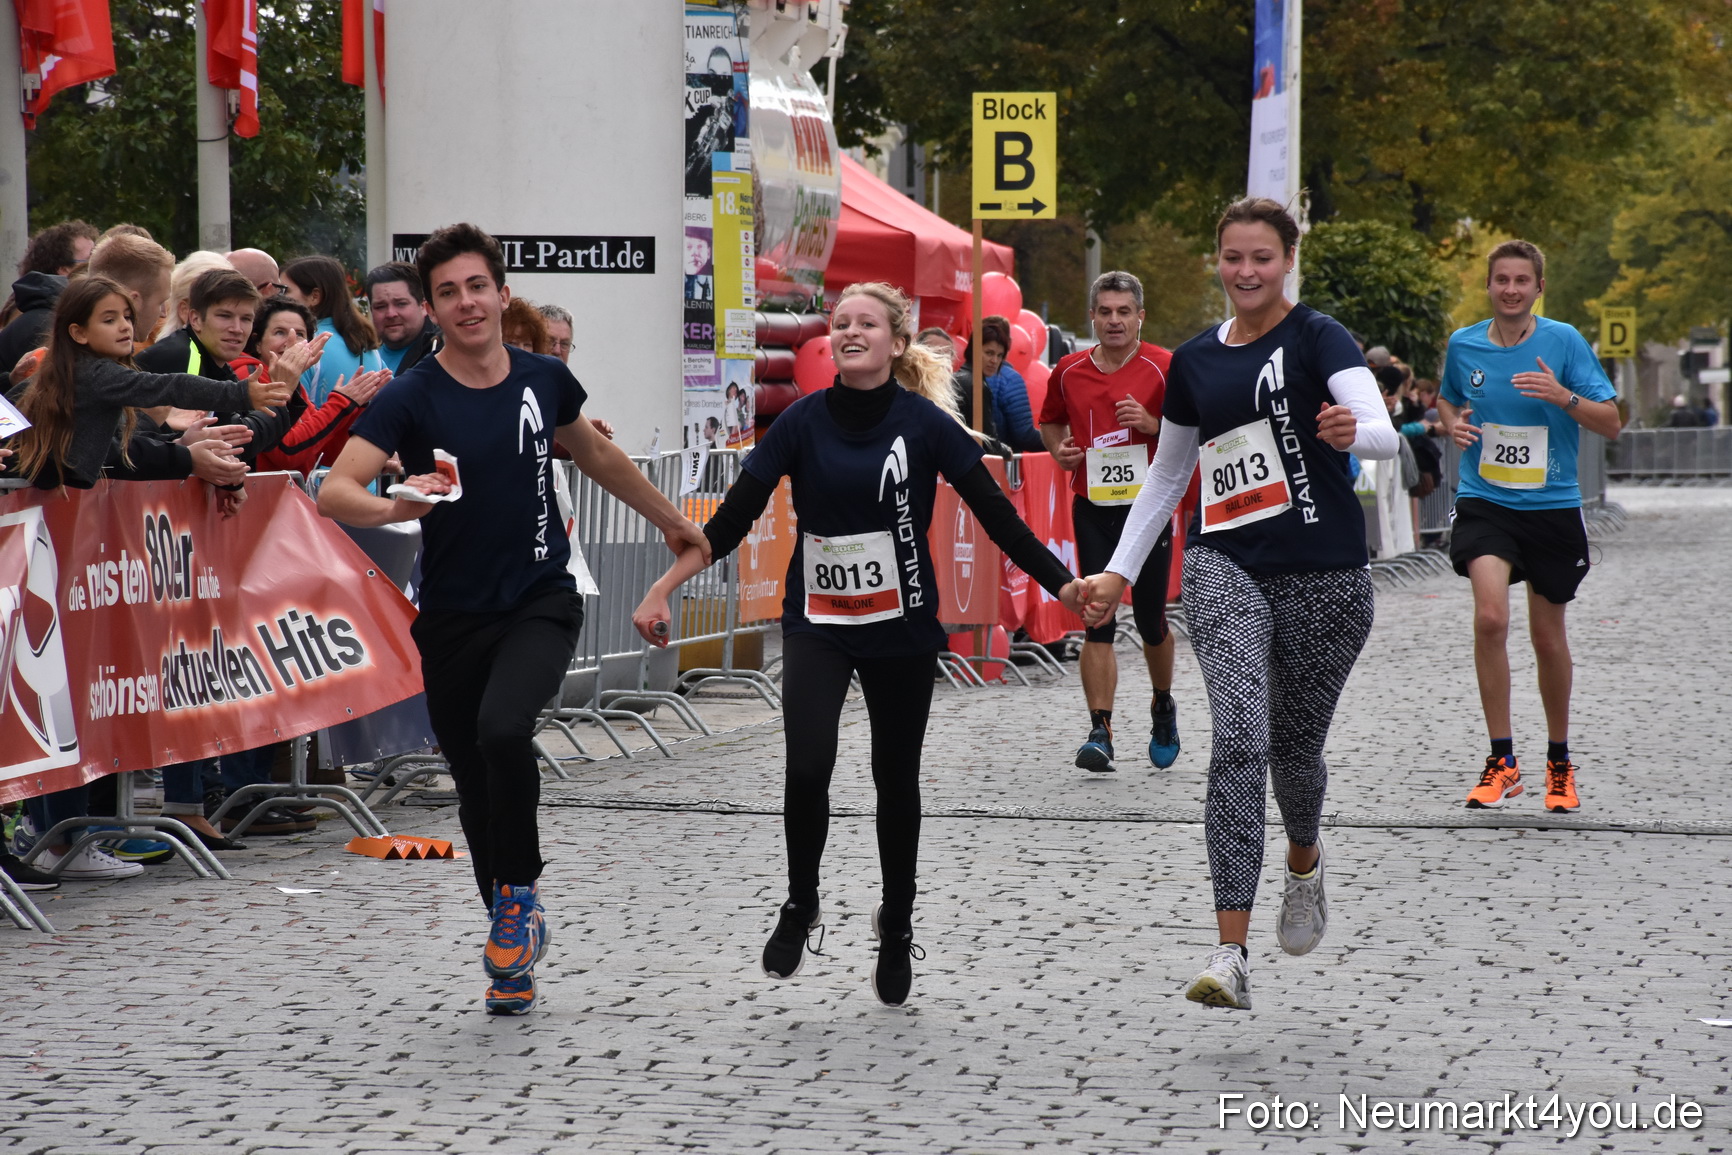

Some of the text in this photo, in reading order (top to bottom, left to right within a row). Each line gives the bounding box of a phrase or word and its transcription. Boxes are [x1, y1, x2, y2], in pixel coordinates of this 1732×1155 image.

[694, 90, 711, 104] CUP
[983, 98, 1046, 120] Block
[995, 131, 1035, 191] B
[716, 191, 739, 215] 18.
[1605, 310, 1631, 319] Block
[1610, 322, 1627, 346] D
[1102, 434, 1119, 444] DEHN
[1271, 397, 1319, 524] RAIL.ONE
[1494, 444, 1530, 465] 283
[1101, 464, 1135, 483] 235
[1212, 452, 1270, 497] 8013
[534, 438, 549, 562] RAIL.ONE
[1110, 488, 1128, 496] Josef
[1225, 492, 1263, 514] RAIL.ONE
[832, 543, 865, 554] BOCK
[896, 488, 923, 608] RAIL.ONE
[68, 575, 86, 611] die
[144, 513, 194, 603] 80er
[815, 561, 883, 591] 8013
[831, 598, 875, 610] RAIL.ONE
[161, 626, 274, 711] aktuellen
[256, 608, 366, 689] Hits
